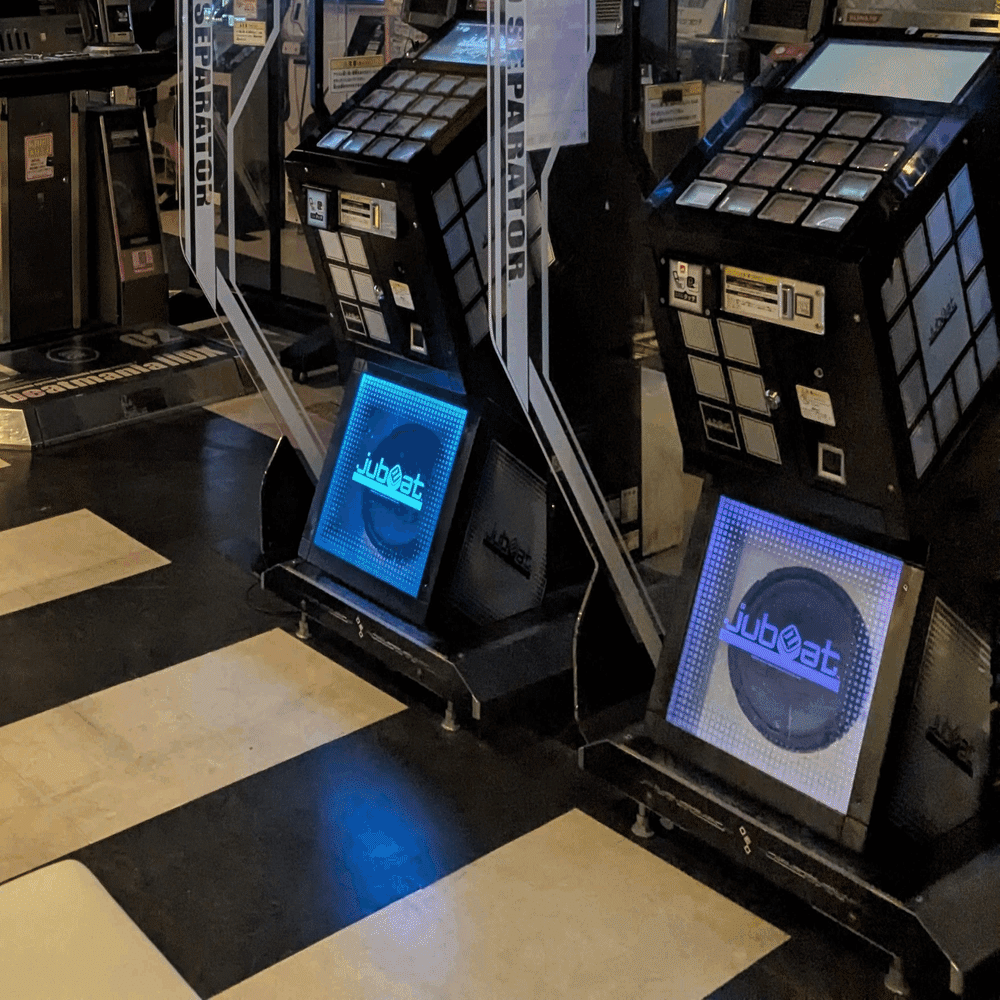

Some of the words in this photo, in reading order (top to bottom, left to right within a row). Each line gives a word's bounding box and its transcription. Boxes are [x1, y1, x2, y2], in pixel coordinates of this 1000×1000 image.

[194, 2, 214, 207] SEPARATOR
[507, 16, 526, 282] SEPARATOR
[356, 451, 425, 501] jubeat
[723, 602, 841, 677] jubeat
